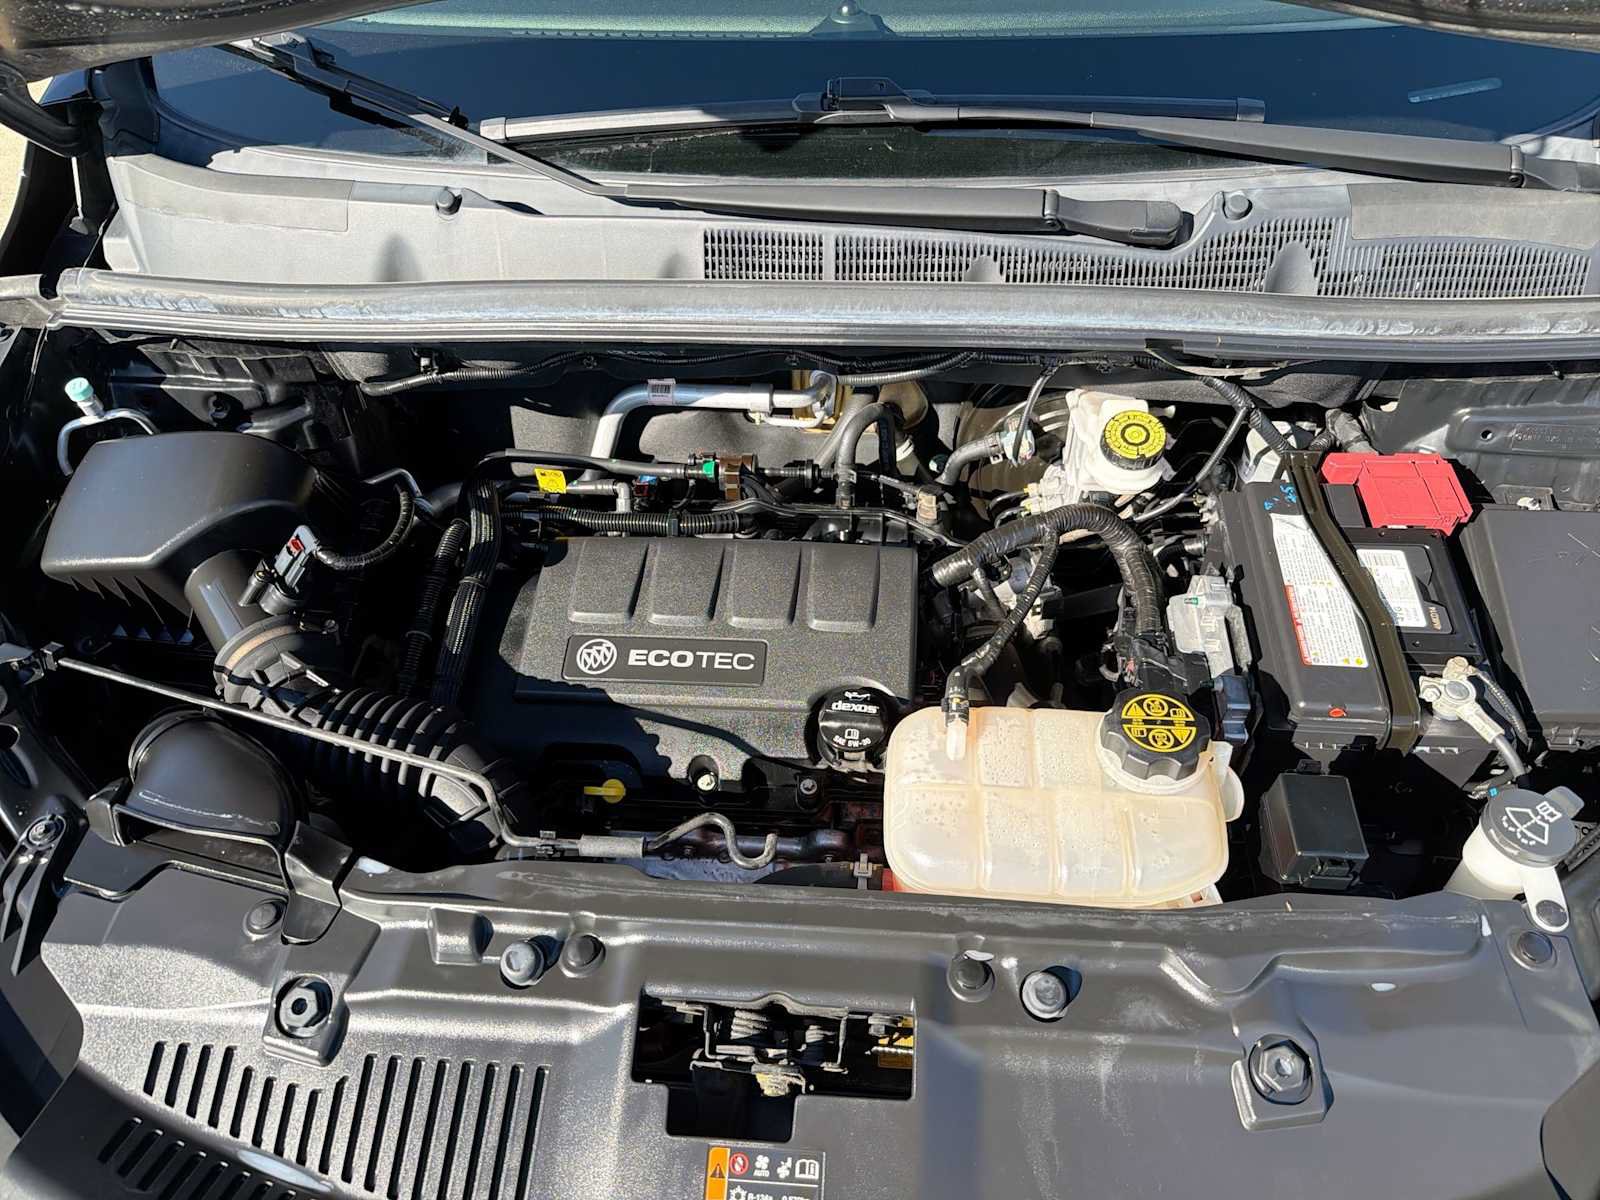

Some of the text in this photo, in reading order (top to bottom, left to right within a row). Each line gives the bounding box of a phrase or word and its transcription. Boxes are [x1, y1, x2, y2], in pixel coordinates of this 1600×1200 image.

[627, 649, 755, 671] ECOTEC
[831, 700, 879, 714] dexos
[832, 735, 872, 748] SAE 5W-30
[753, 1169, 770, 1177] AUTO
